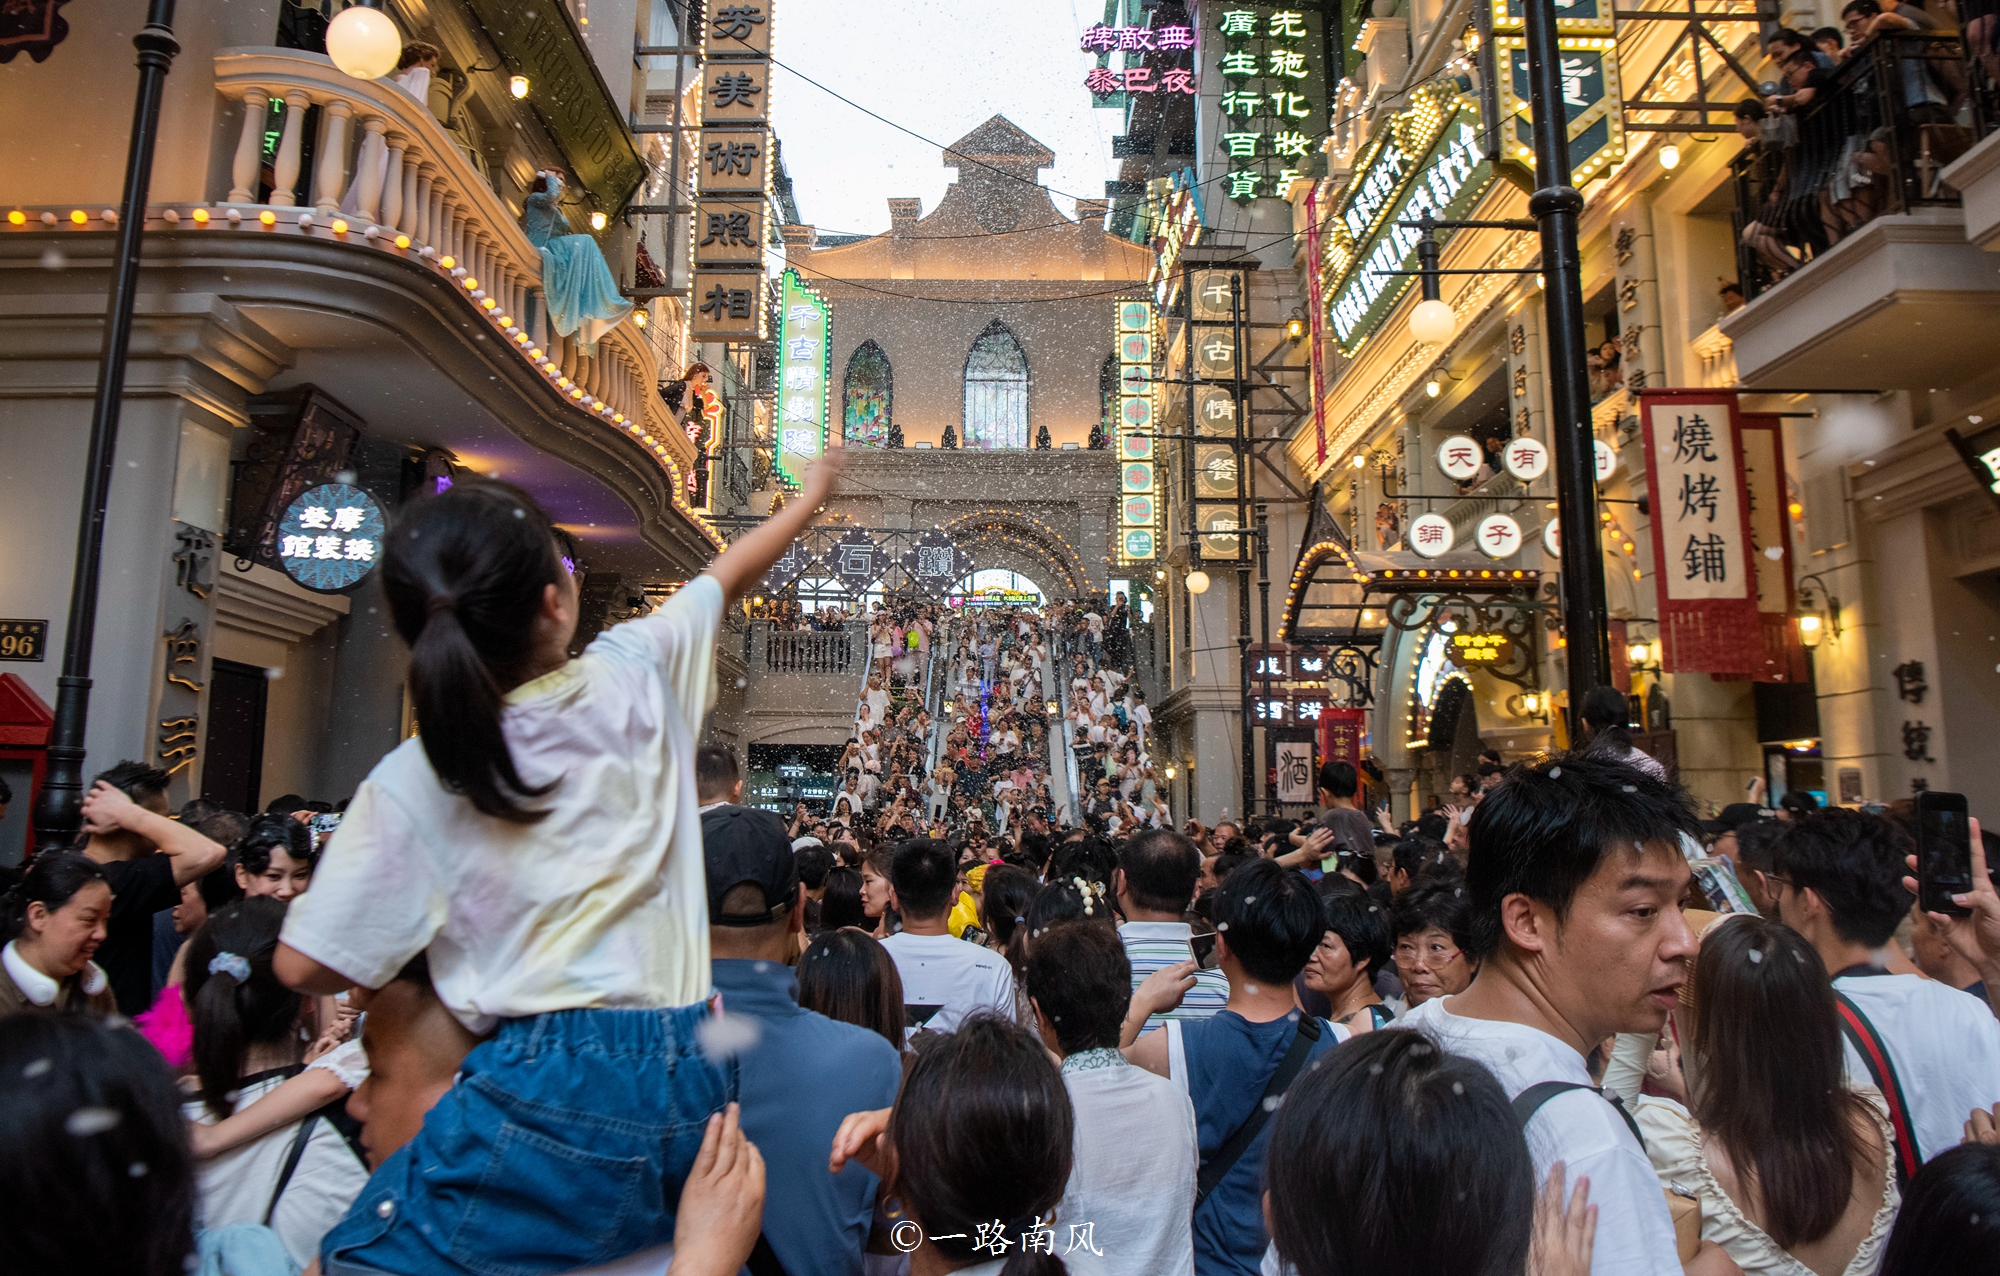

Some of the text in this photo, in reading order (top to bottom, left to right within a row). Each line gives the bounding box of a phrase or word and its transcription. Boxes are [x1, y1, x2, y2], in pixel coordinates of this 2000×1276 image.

[1080, 25, 1195, 51] 無敵牌
[1086, 67, 1197, 94] 夜巴黎
[1220, 9, 1262, 200] 廣生行百貨
[698, 4, 766, 321] 芳美術照相
[783, 304, 821, 455] 千古情劇院
[1672, 413, 1728, 584] 燒烤鋪
[299, 506, 366, 532] 摩登
[280, 534, 375, 562] 換裝館
[1416, 523, 1560, 546] 子鋪
[1, 635, 34, 656] 96
[1280, 750, 1308, 793] 酒
